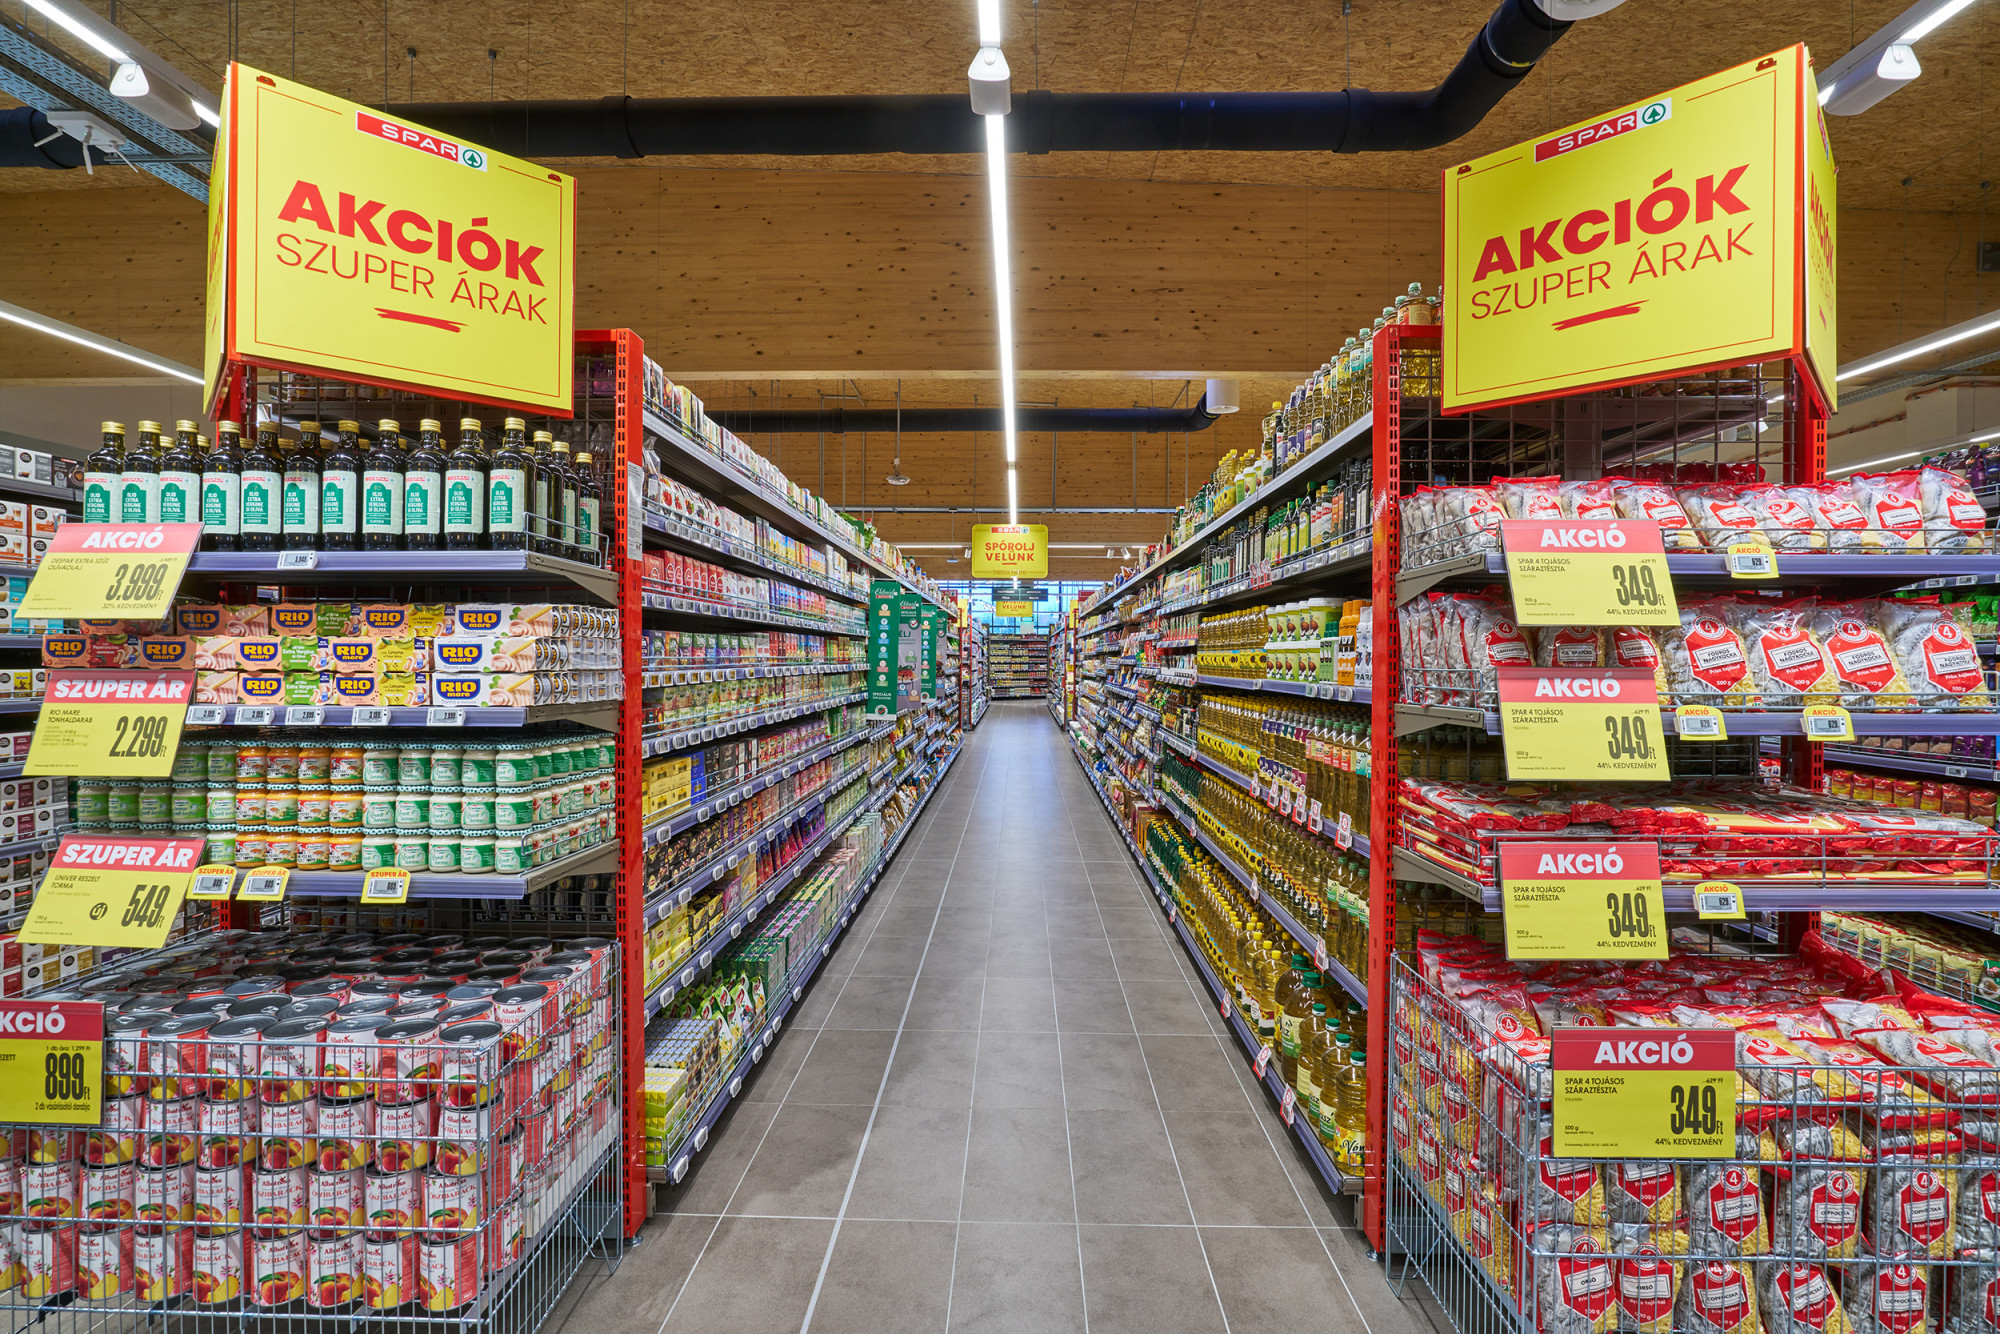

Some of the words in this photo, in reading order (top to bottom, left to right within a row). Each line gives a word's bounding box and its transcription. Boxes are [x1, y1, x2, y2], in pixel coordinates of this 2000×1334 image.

[381, 123, 457, 159] SPAR
[1558, 114, 1636, 152] SPAR
[1472, 163, 1751, 282] AKCIÓK
[278, 180, 545, 287] AKCIÓK
[276, 233, 434, 298] SZUPER
[450, 271, 547, 324] ÁRAK
[1471, 261, 1611, 319] SZUPER
[1628, 223, 1754, 285] ÁRAK
[81, 526, 164, 548] AKCIÓ
[1541, 523, 1626, 548] AKCIÓ
[985, 540, 1035, 551] SPÓROLJ
[986, 550, 1034, 561] VELÜNK
[105, 563, 168, 600] 3.999
[156, 590, 163, 600] Ft
[1613, 565, 1659, 606] 349
[1658, 594, 1666, 606] Ft
[183, 613, 214, 623] RIO
[279, 612, 309, 621] RIO
[370, 612, 400, 622] RIO
[463, 613, 497, 623] RIO
[1848, 624, 1858, 635] 4
[1942, 626, 1952, 637] 4
[50, 642, 82, 651] RIO
[146, 644, 182, 655] RIO
[244, 645, 275, 655] RIO
[1708, 649, 1730, 657] FODROS
[1783, 648, 1807, 657] FODROS
[54, 679, 147, 698] SZUPER
[148, 673, 185, 698] ÁR
[1535, 671, 1620, 697] AKCIÓ
[109, 716, 168, 757] 2.299
[160, 746, 167, 757] Ft
[1605, 716, 1650, 759] 349
[1649, 747, 1656, 760] Ft
[62, 844, 154, 866] SZUPER
[154, 841, 194, 867] ÁR
[1537, 846, 1623, 874] AKCIÓ
[398, 870, 407, 878] ÁR
[1704, 884, 1728, 892] AKCIÓ
[121, 885, 170, 928] 549
[156, 916, 165, 928] Ft
[1607, 893, 1649, 938] 349
[1649, 925, 1656, 938] Ft
[1613, 940, 1657, 948] KEDVEZMÉNY
[1505, 1019, 1514, 1031] 4
[1594, 1033, 1694, 1064] AKCIÓ
[45, 1053, 84, 1100] 899
[84, 1087, 90, 1100] Ft
[1592, 1076, 1625, 1085] TOJÁSOS
[1565, 1086, 1617, 1094] SZÁRAZTÉSZTA
[35, 1102, 38, 1110] 2
[39, 1102, 45, 1110] db
[73, 1103, 90, 1112] darabja
[1671, 1085, 1716, 1135] 349
[1716, 1121, 1723, 1135] Ft
[1673, 1138, 1723, 1146] KEDVEZMÉNY
